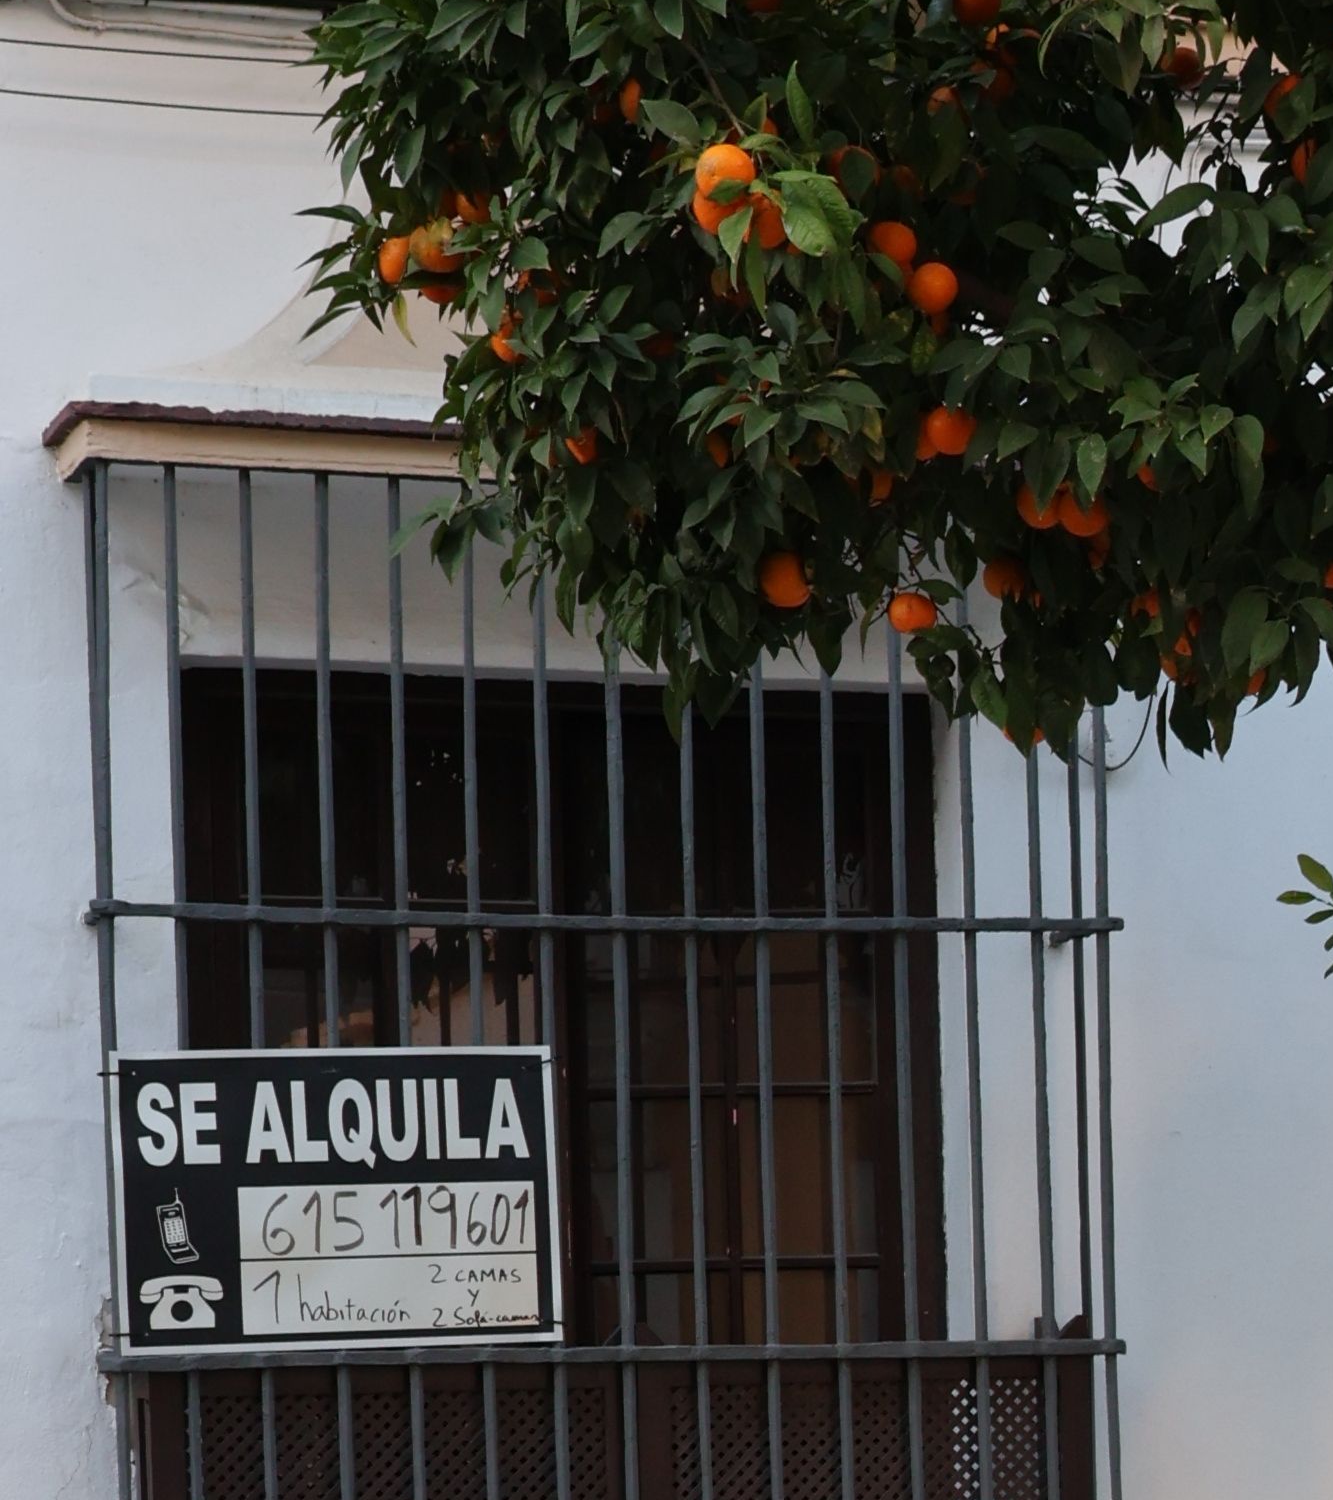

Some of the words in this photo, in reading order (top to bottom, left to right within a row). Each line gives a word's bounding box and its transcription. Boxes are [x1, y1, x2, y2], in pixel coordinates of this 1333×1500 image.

[136, 1082, 221, 1167] SE
[245, 1078, 530, 1169] ALQUILA
[428, 1264, 447, 1284] 2
[454, 1267, 522, 1284] CAMAS
[297, 1273, 411, 1323] habitación
[432, 1307, 447, 1328] 2
